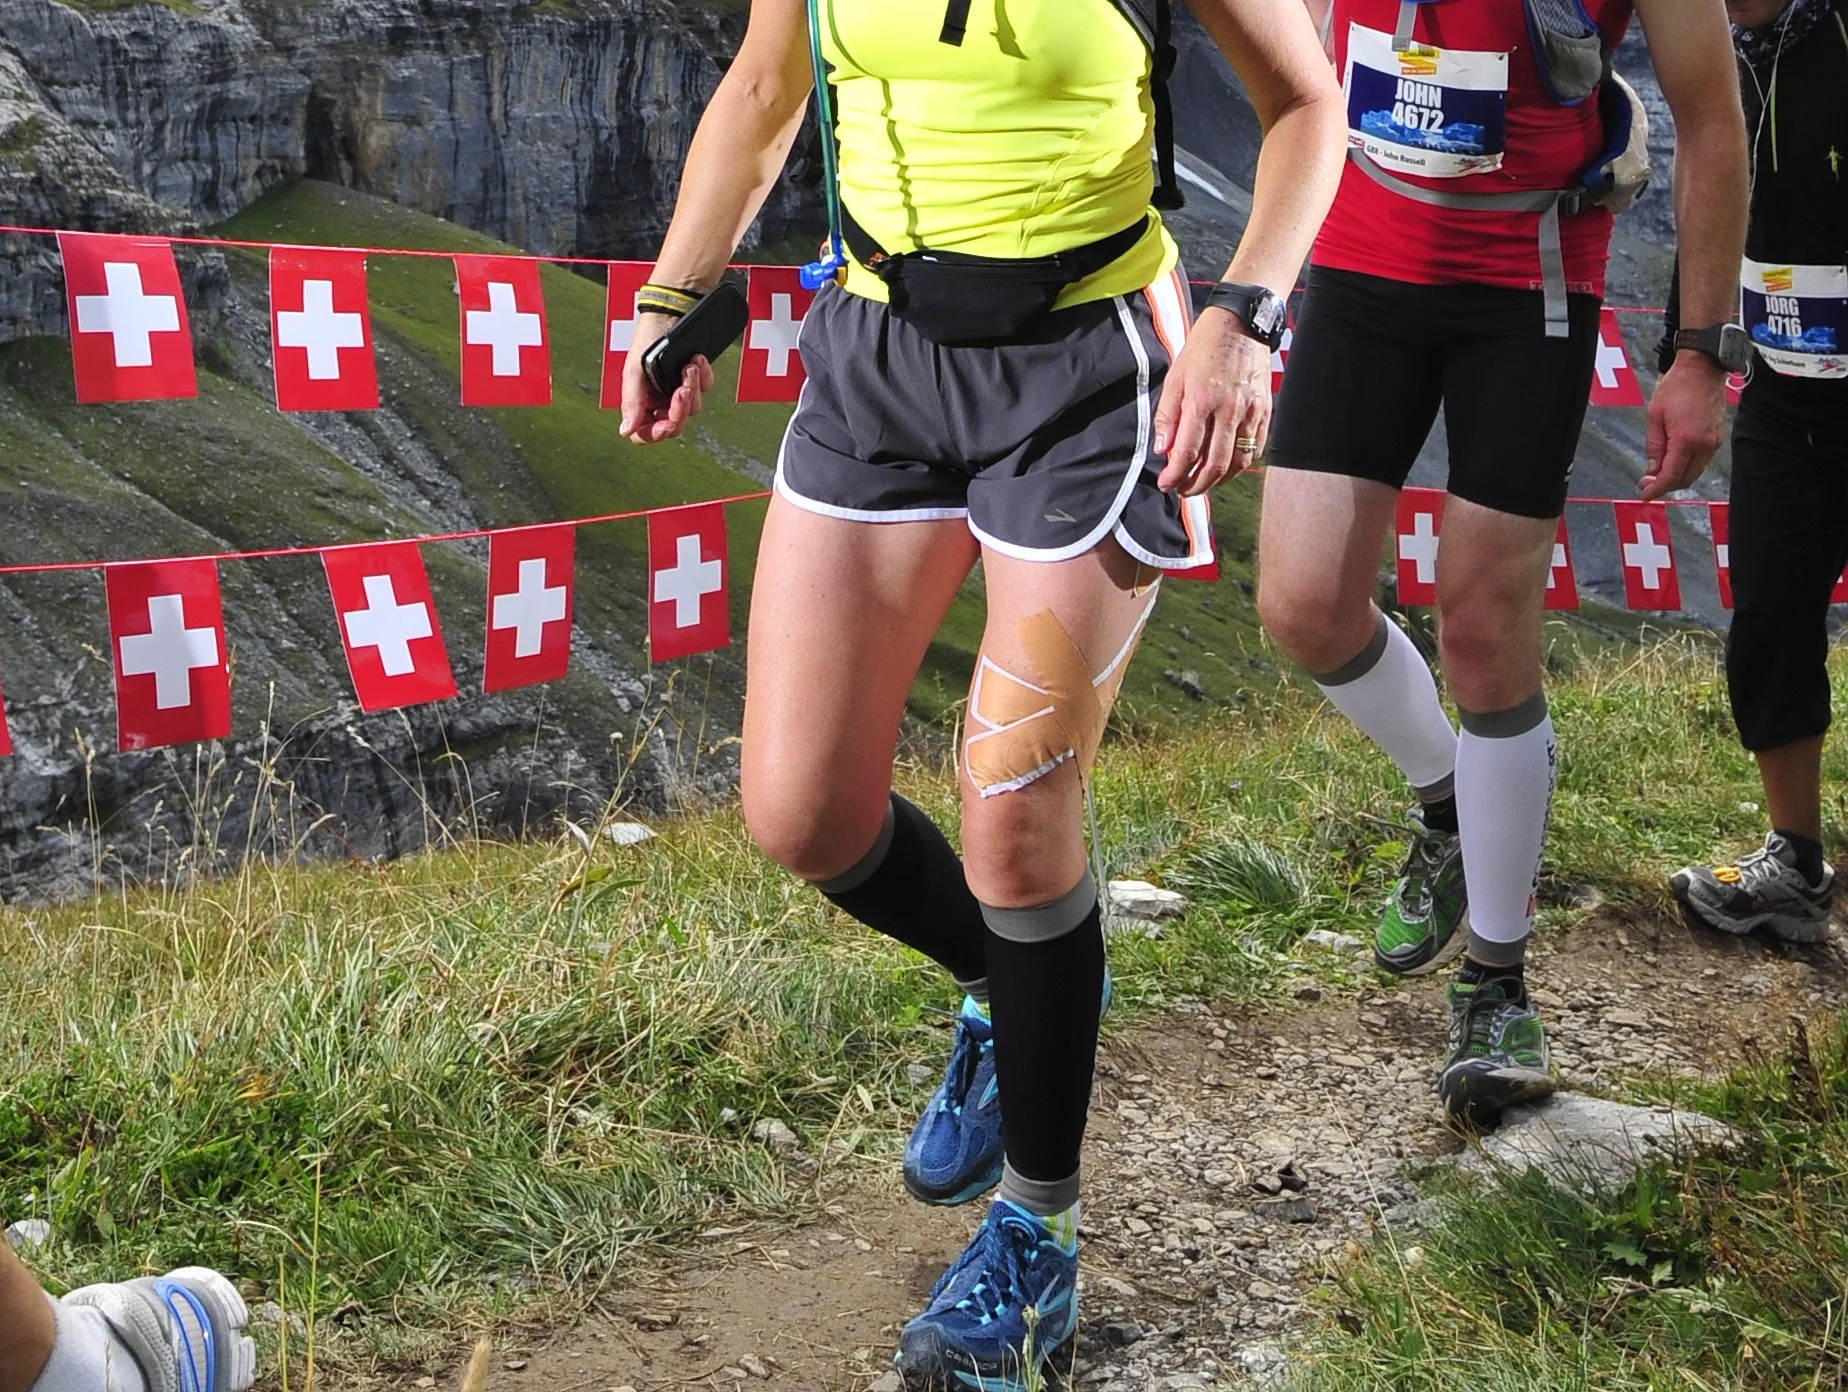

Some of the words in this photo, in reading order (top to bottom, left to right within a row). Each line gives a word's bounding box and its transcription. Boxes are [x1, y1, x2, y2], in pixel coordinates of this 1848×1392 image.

[1395, 78, 1442, 109] JOHN
[1391, 101, 1445, 134] 4672
[1767, 314, 1802, 338] 4716
